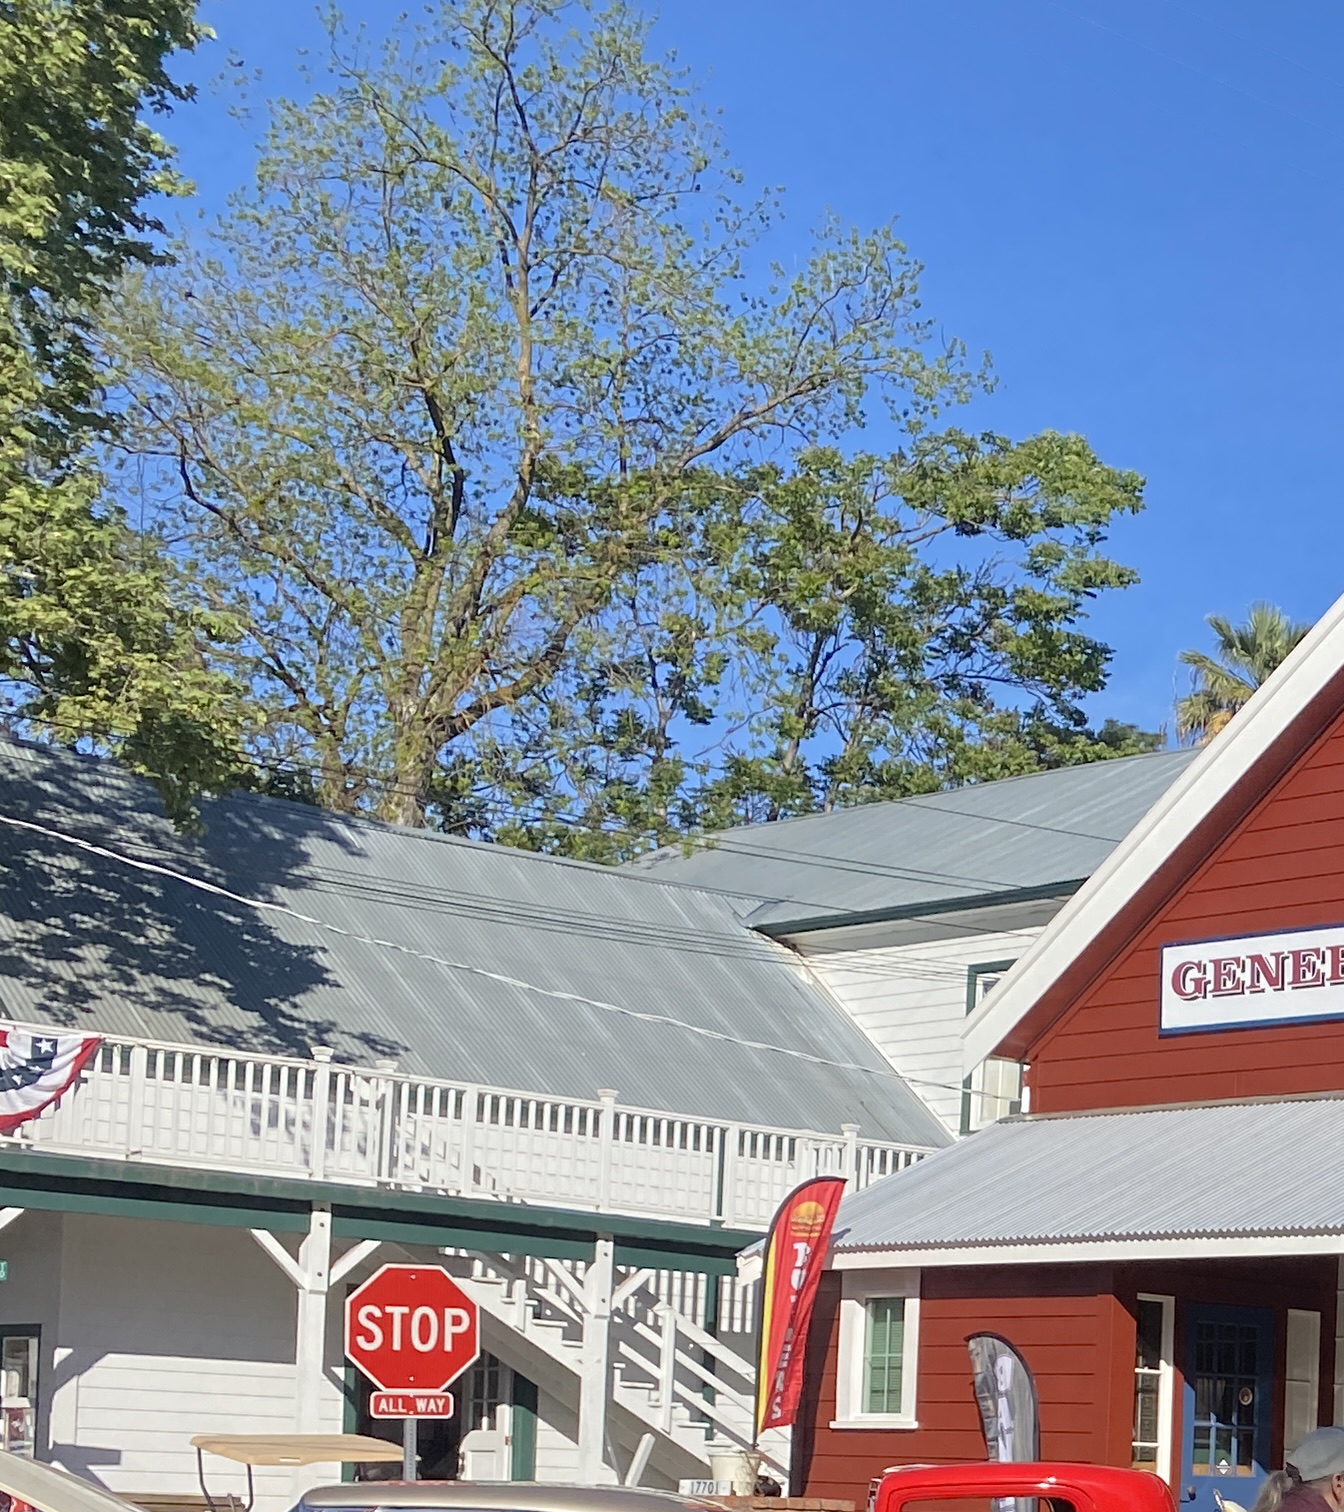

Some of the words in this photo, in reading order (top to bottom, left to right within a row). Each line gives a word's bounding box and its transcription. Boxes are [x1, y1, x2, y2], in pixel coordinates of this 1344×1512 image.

[356, 1304, 471, 1352] STOP
[378, 1398, 407, 1412] ALL
[415, 1398, 446, 1412] WAY
[691, 1481, 719, 1494] 17701
